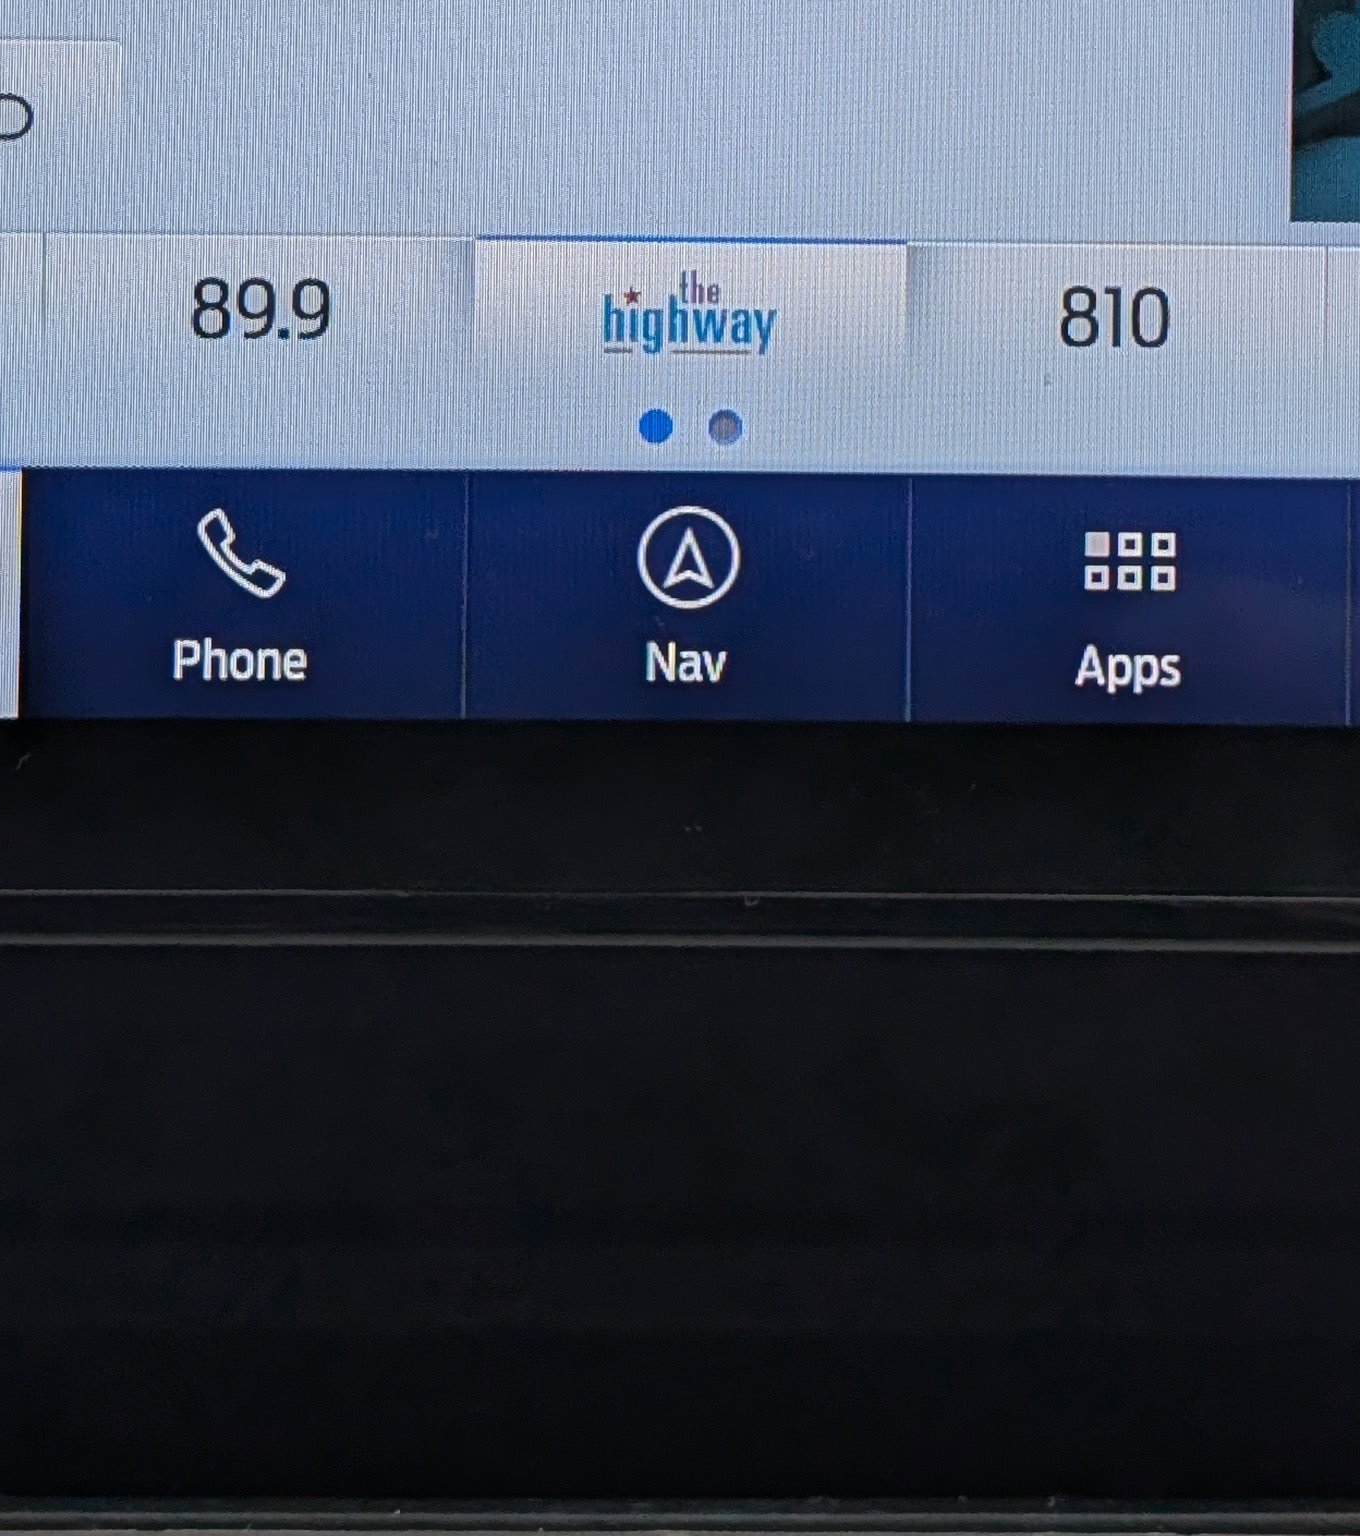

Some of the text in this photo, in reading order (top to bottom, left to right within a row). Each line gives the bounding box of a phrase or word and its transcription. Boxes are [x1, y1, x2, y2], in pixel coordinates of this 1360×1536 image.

[191, 277, 331, 340] 89.9
[679, 270, 720, 304] the
[603, 293, 777, 355] highway
[1060, 286, 1170, 349] 810
[174, 637, 308, 682] Phone
[646, 641, 727, 683] Nav
[1075, 644, 1181, 694] Apps
